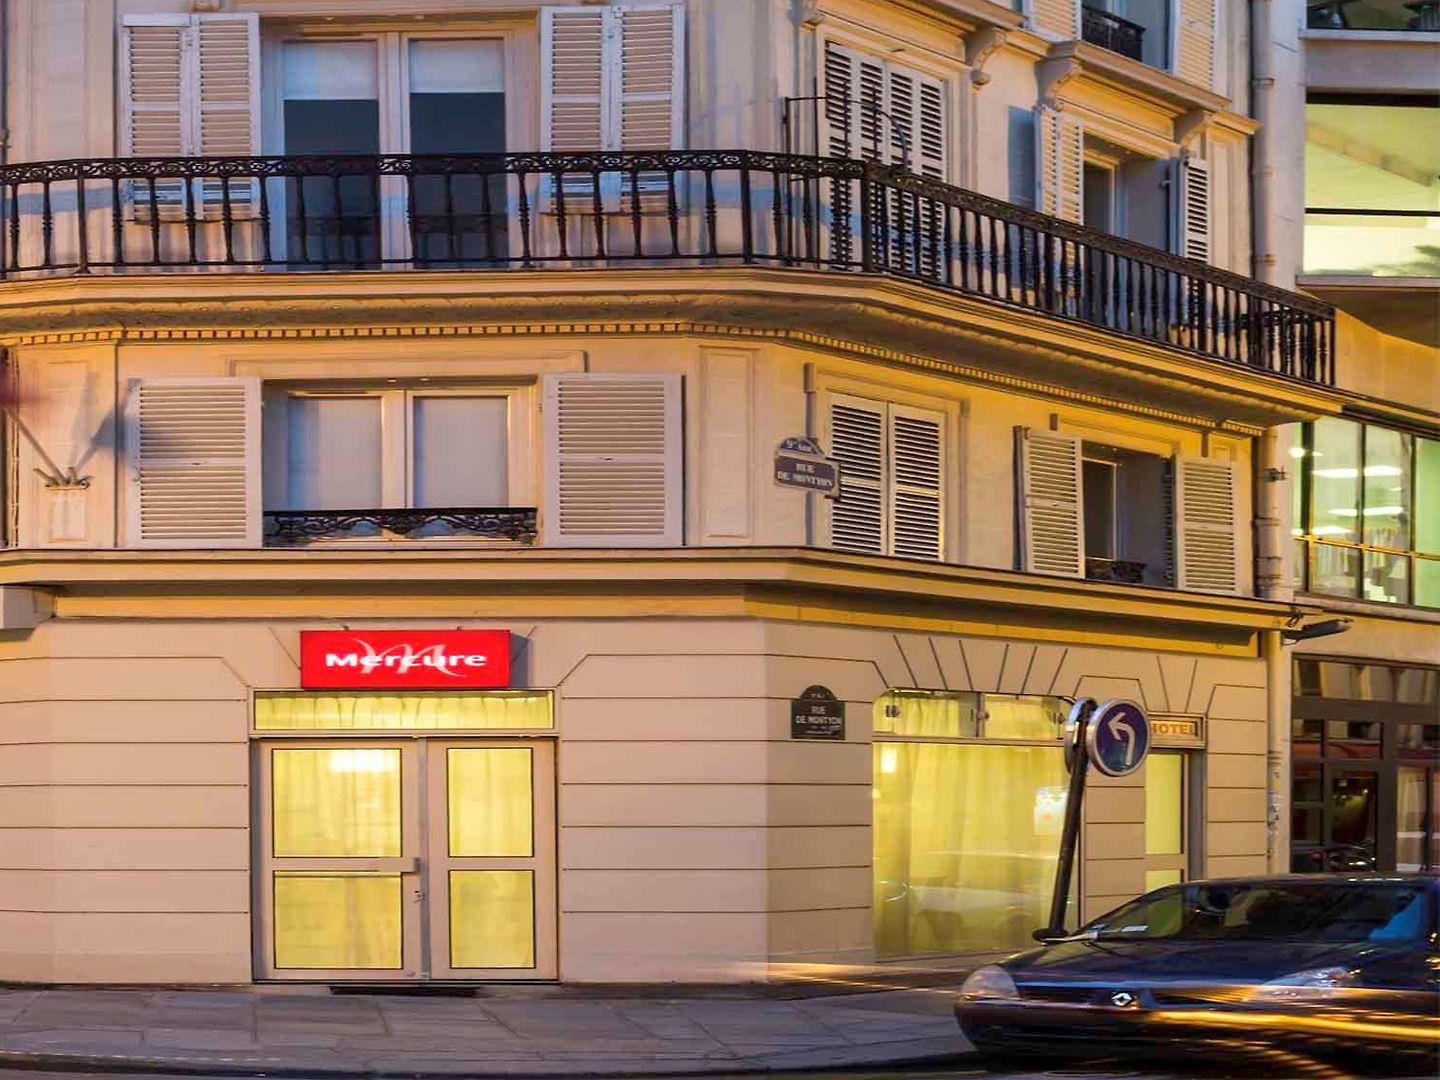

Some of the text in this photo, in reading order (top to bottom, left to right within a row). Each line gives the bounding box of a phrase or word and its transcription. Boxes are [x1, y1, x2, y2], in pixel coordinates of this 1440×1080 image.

[777, 471, 791, 481] DE
[325, 651, 488, 668] Mercure
[795, 715, 807, 724] DE
